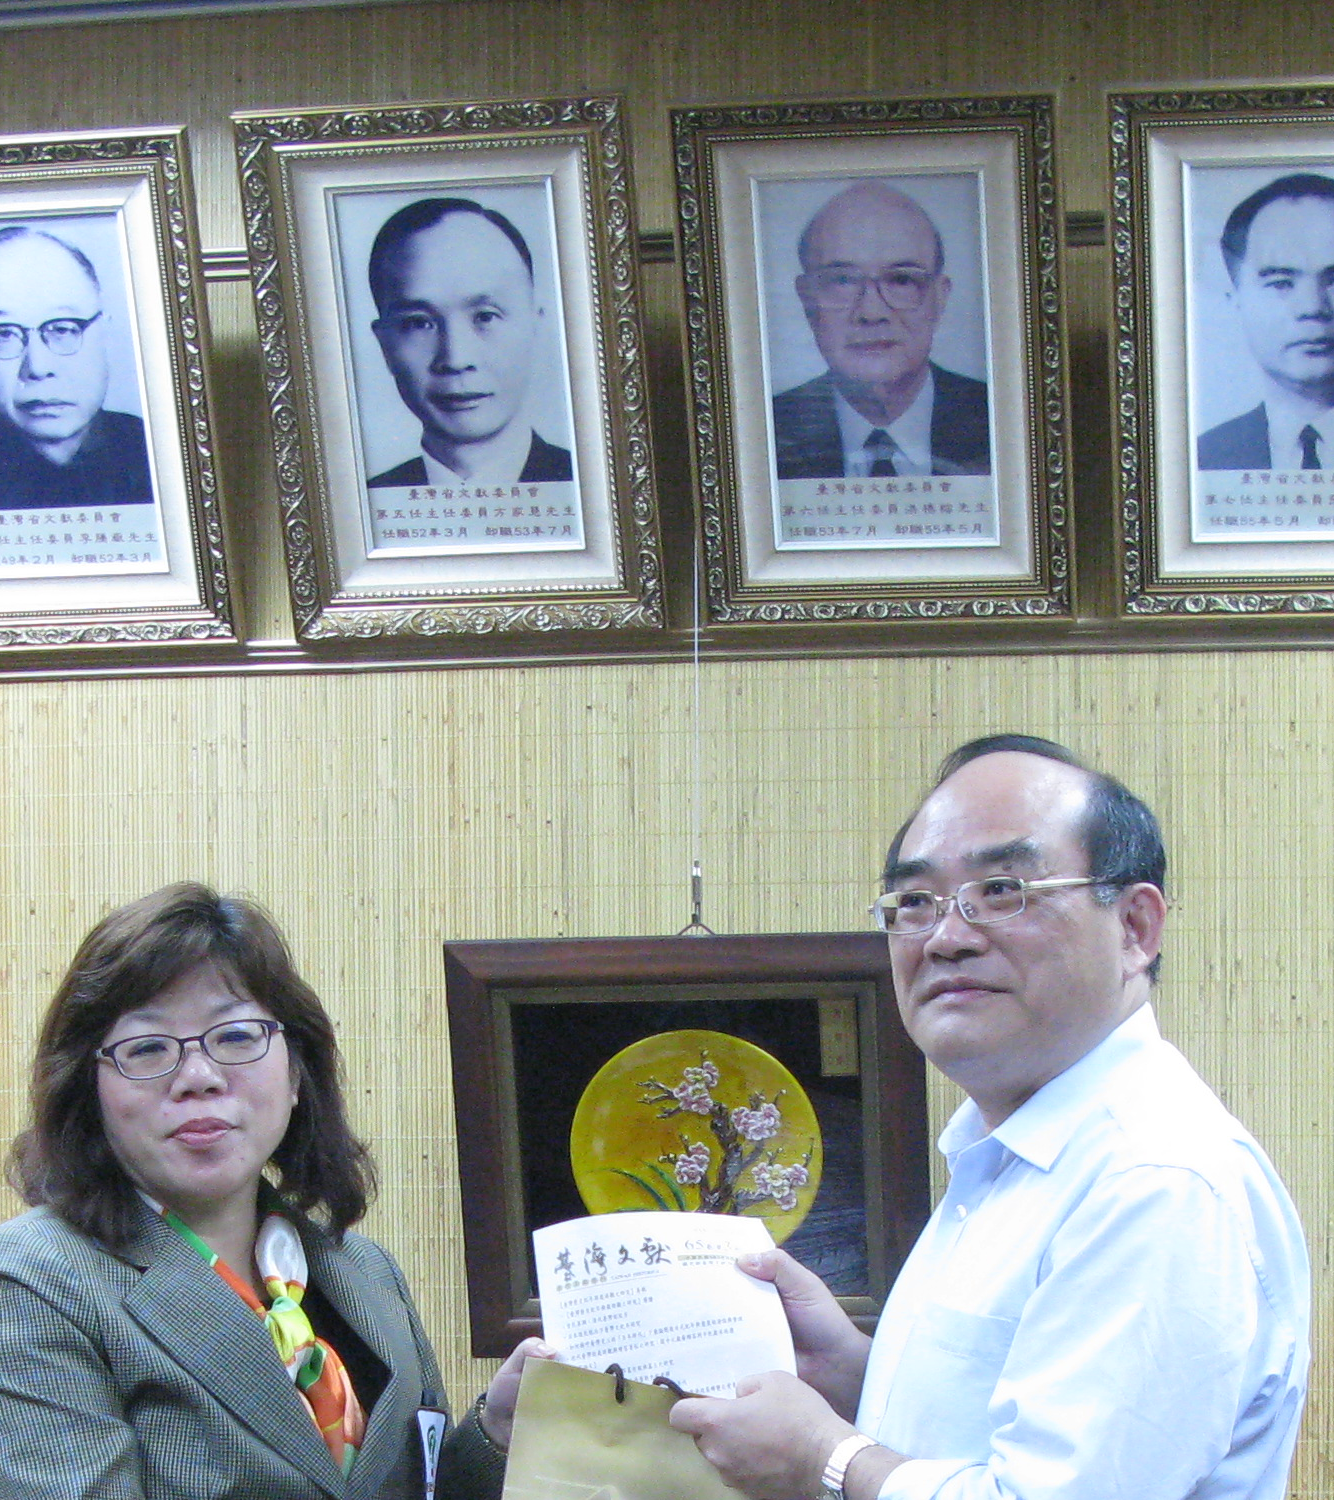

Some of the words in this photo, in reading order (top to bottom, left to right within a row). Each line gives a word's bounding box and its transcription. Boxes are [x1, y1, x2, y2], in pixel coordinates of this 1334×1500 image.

[408, 486, 540, 501] 臺灣省文獻委員會
[815, 481, 952, 496] 臺灣省文獻委員會
[382, 527, 469, 539] 任職52年3月
[484, 525, 573, 537] 卸職53年7月
[789, 525, 878, 537] 任職53年7月
[894, 523, 983, 535] 卸職55年5月
[71, 552, 153, 564] 卸職52年3月
